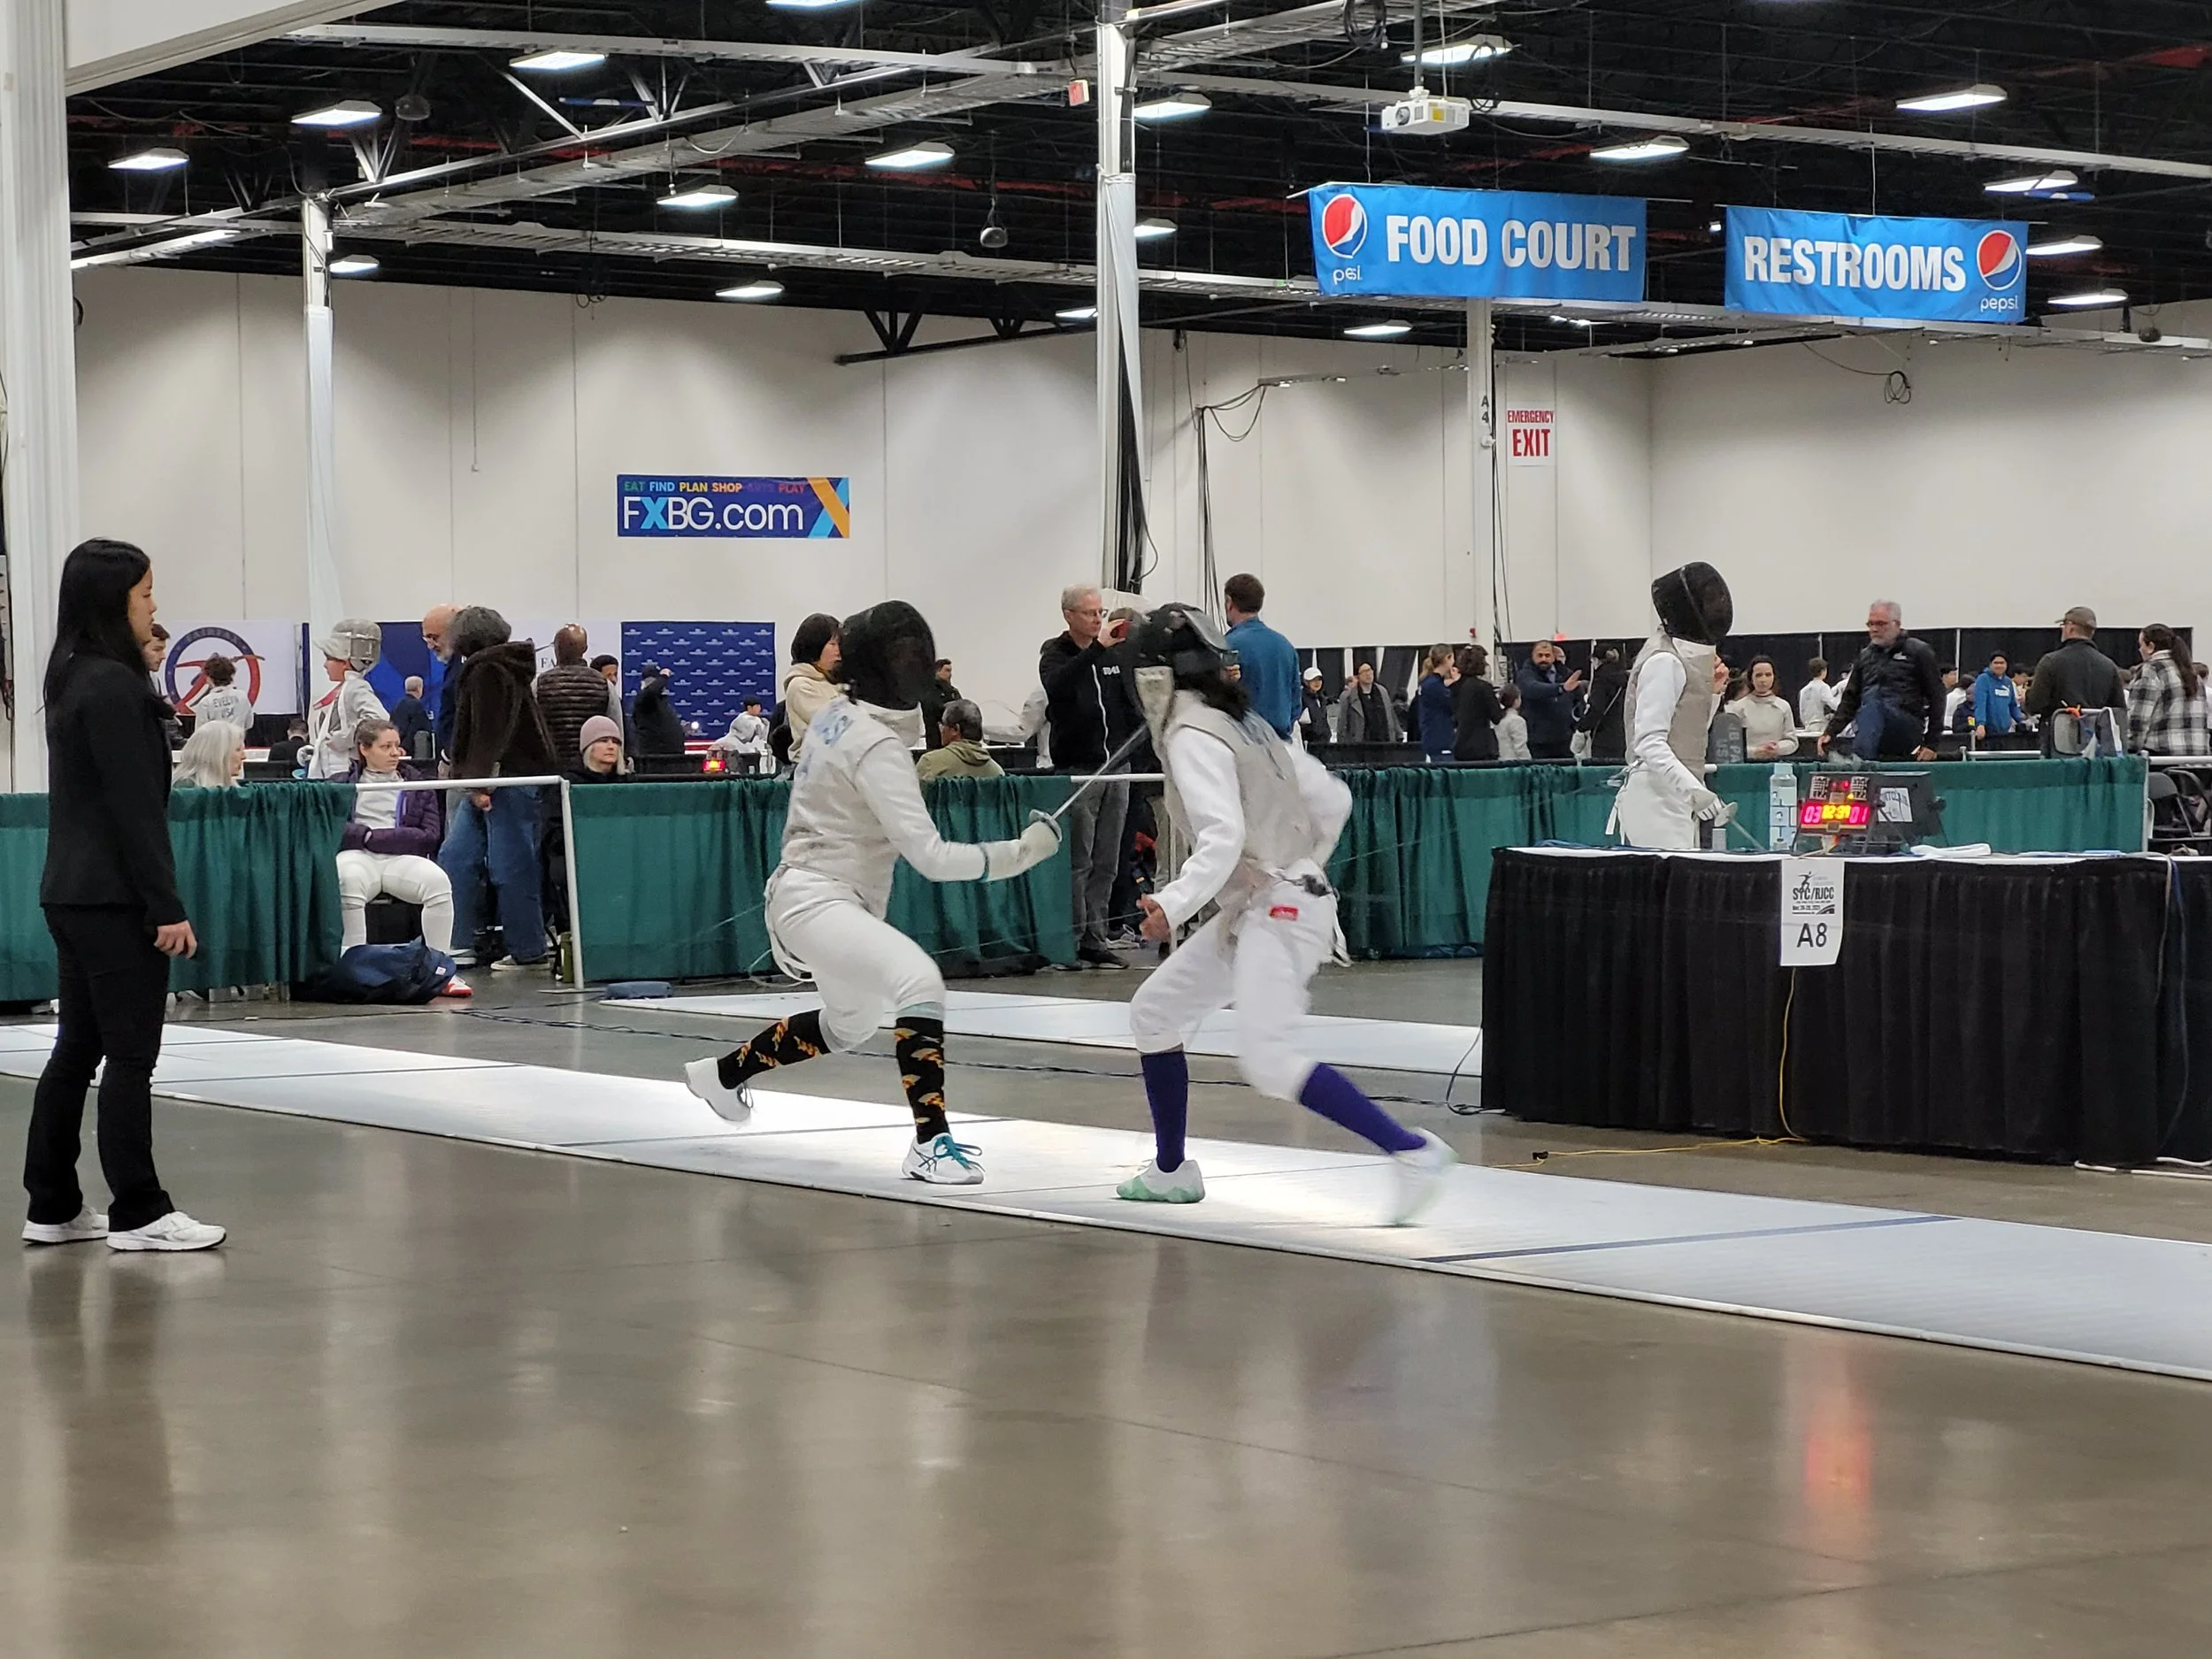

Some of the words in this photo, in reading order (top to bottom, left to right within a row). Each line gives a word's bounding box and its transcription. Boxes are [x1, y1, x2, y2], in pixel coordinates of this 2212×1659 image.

[1386, 215, 1488, 265] FOOD
[1502, 219, 1637, 271] COURT
[1744, 236, 1967, 292] RESTROOMS
[1980, 295, 2019, 312] pepsi
[1507, 410, 1555, 423] EMERGENCY
[1512, 428, 1551, 457] EXIT
[624, 481, 645, 492] EAT
[649, 481, 675, 492] FIND
[680, 482, 708, 492] PLAN
[711, 482, 742, 493] SHOP
[779, 483, 805, 494] PLAY
[624, 496, 803, 531] FXBG.com
[1804, 805, 1823, 824] 03
[1849, 805, 1869, 824] 01
[1797, 922, 1827, 949] A8
